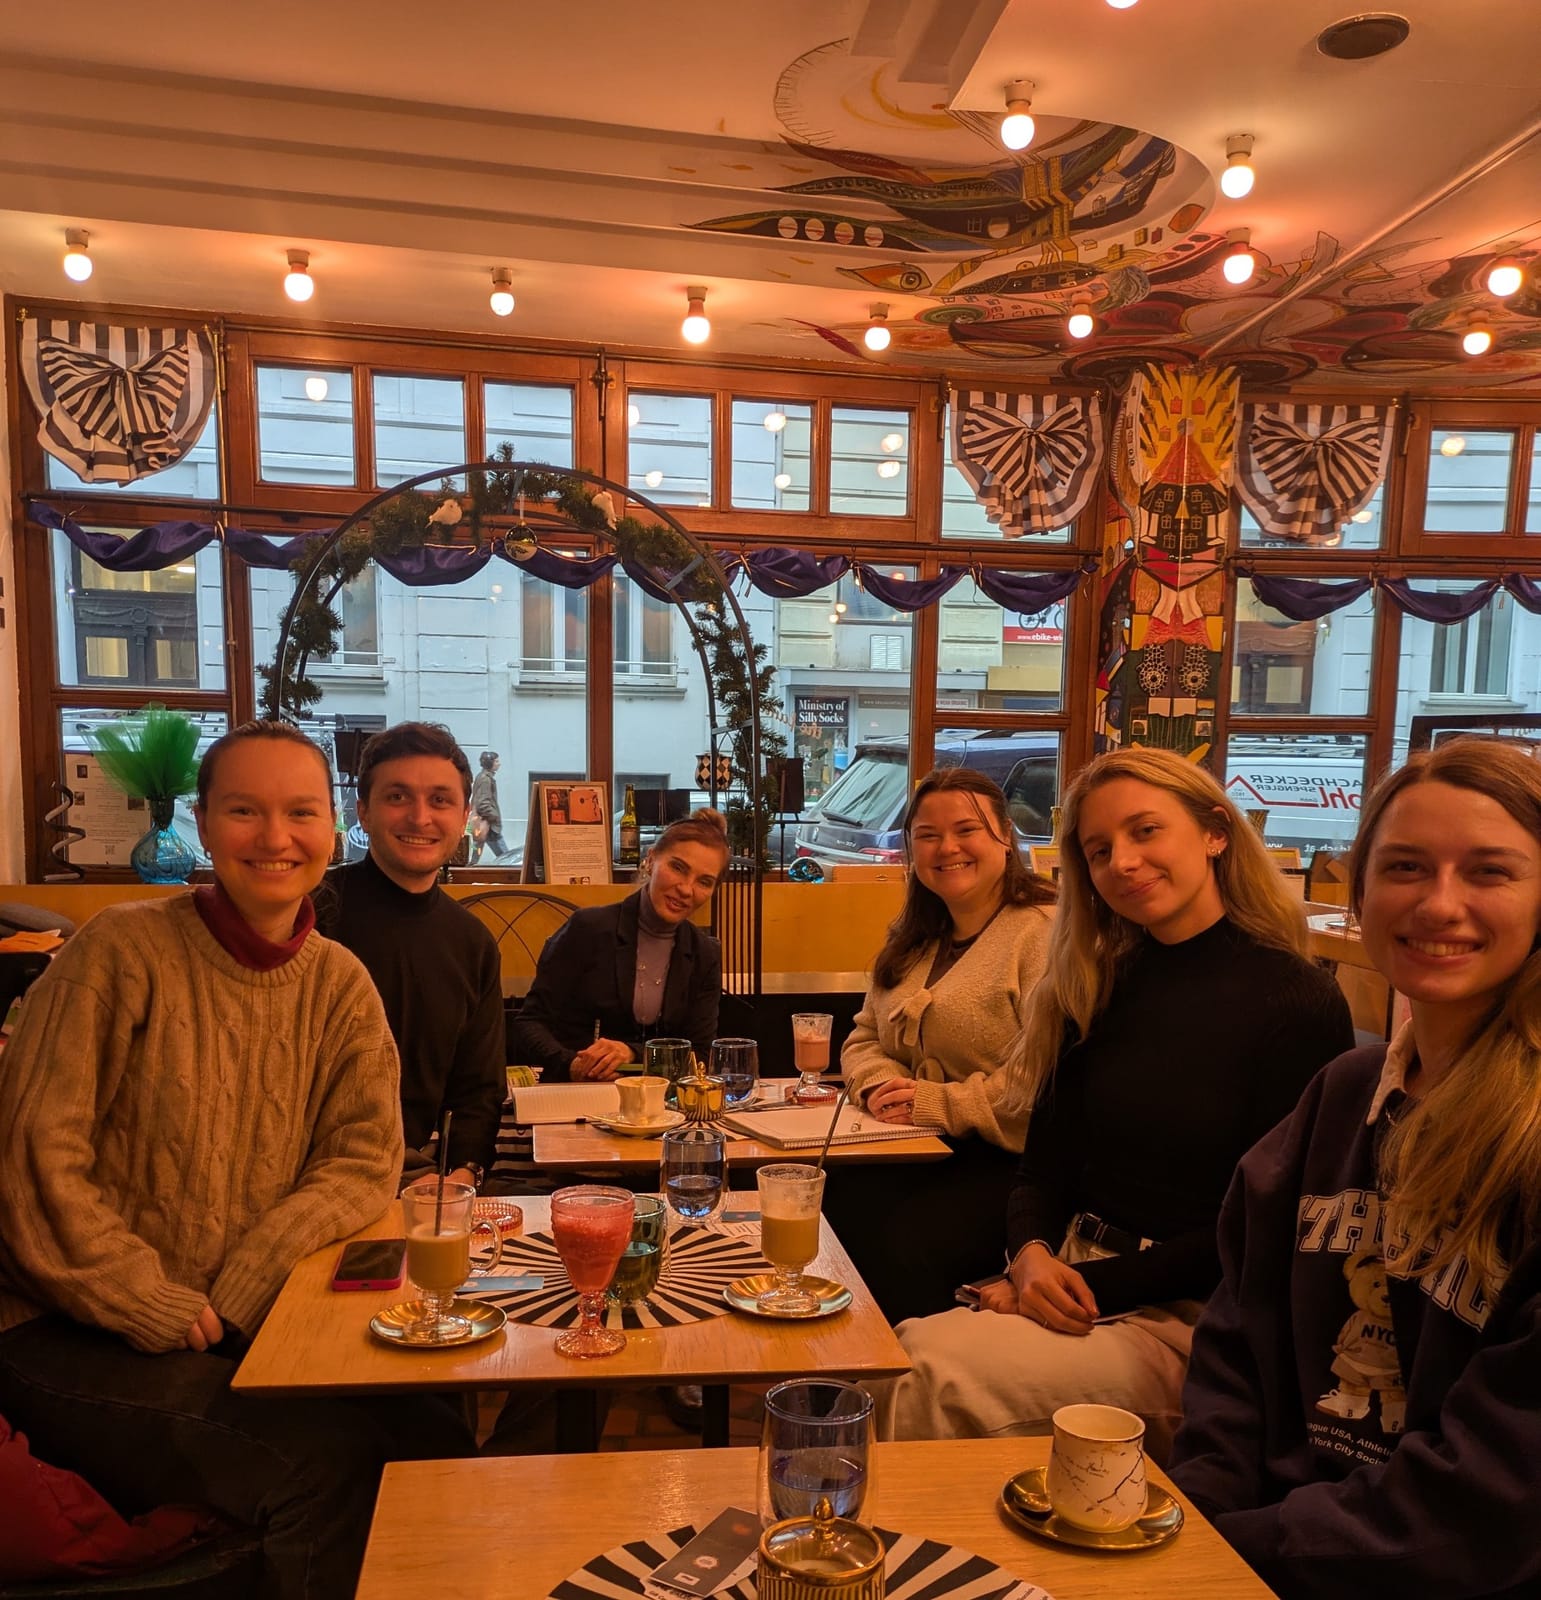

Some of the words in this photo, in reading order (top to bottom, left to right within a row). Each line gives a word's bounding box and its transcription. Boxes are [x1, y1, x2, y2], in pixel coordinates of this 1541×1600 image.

[798, 699, 834, 713] Ministry
[835, 700, 846, 711] of
[798, 711, 818, 724] Silly
[819, 711, 844, 723] Socks
[1313, 1436, 1333, 1449] York
[1334, 1442, 1355, 1456] City
